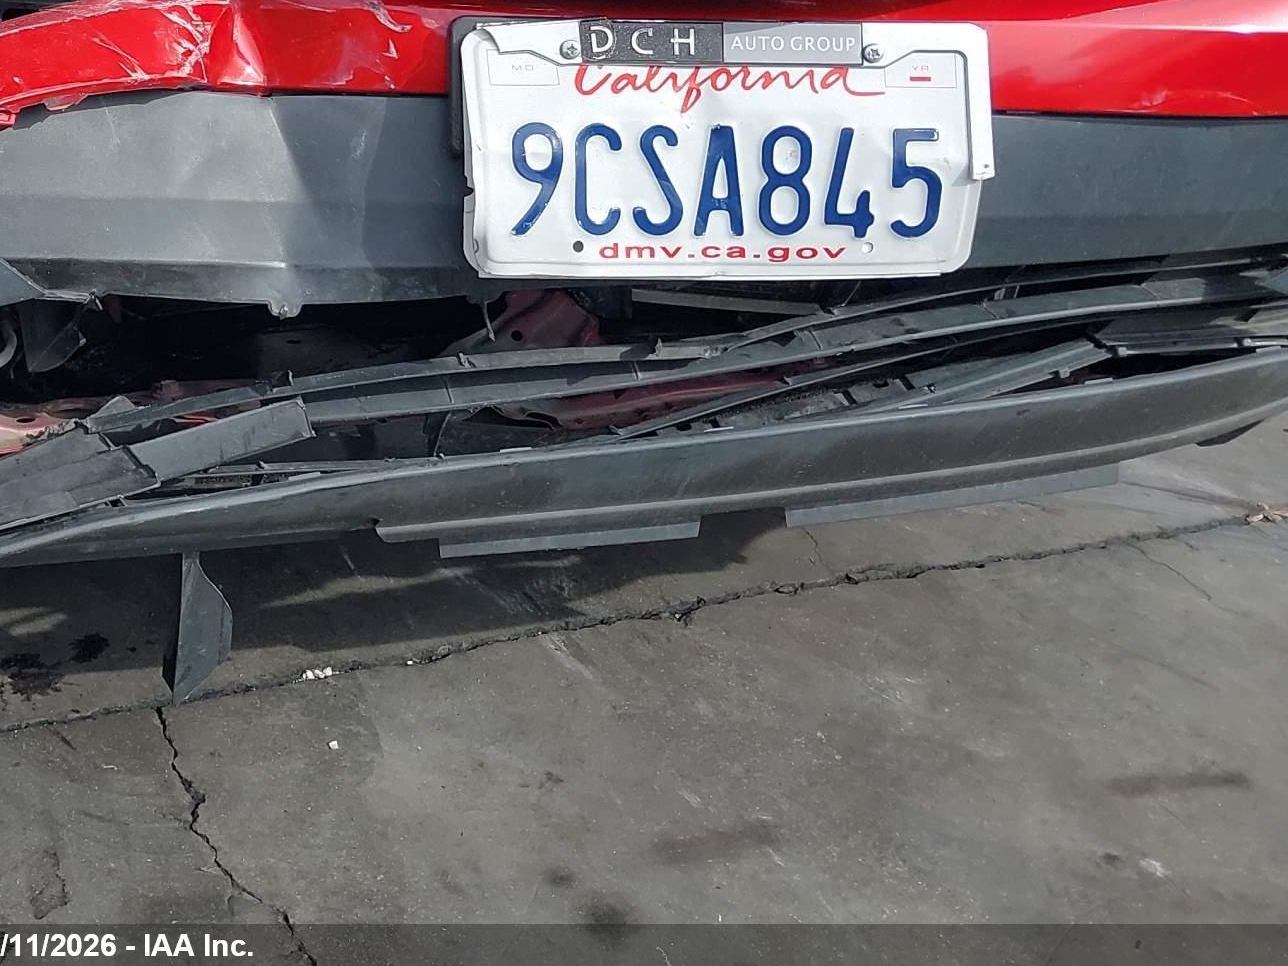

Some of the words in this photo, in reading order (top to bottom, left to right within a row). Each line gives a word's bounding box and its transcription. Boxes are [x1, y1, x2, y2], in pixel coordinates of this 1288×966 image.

[730, 34, 785, 52] AUTO
[790, 35, 856, 53] GROUP
[511, 64, 535, 72] MO
[573, 65, 886, 115] California
[510, 121, 942, 239] 9CSA845
[598, 242, 847, 262] dmv.ca.gov
